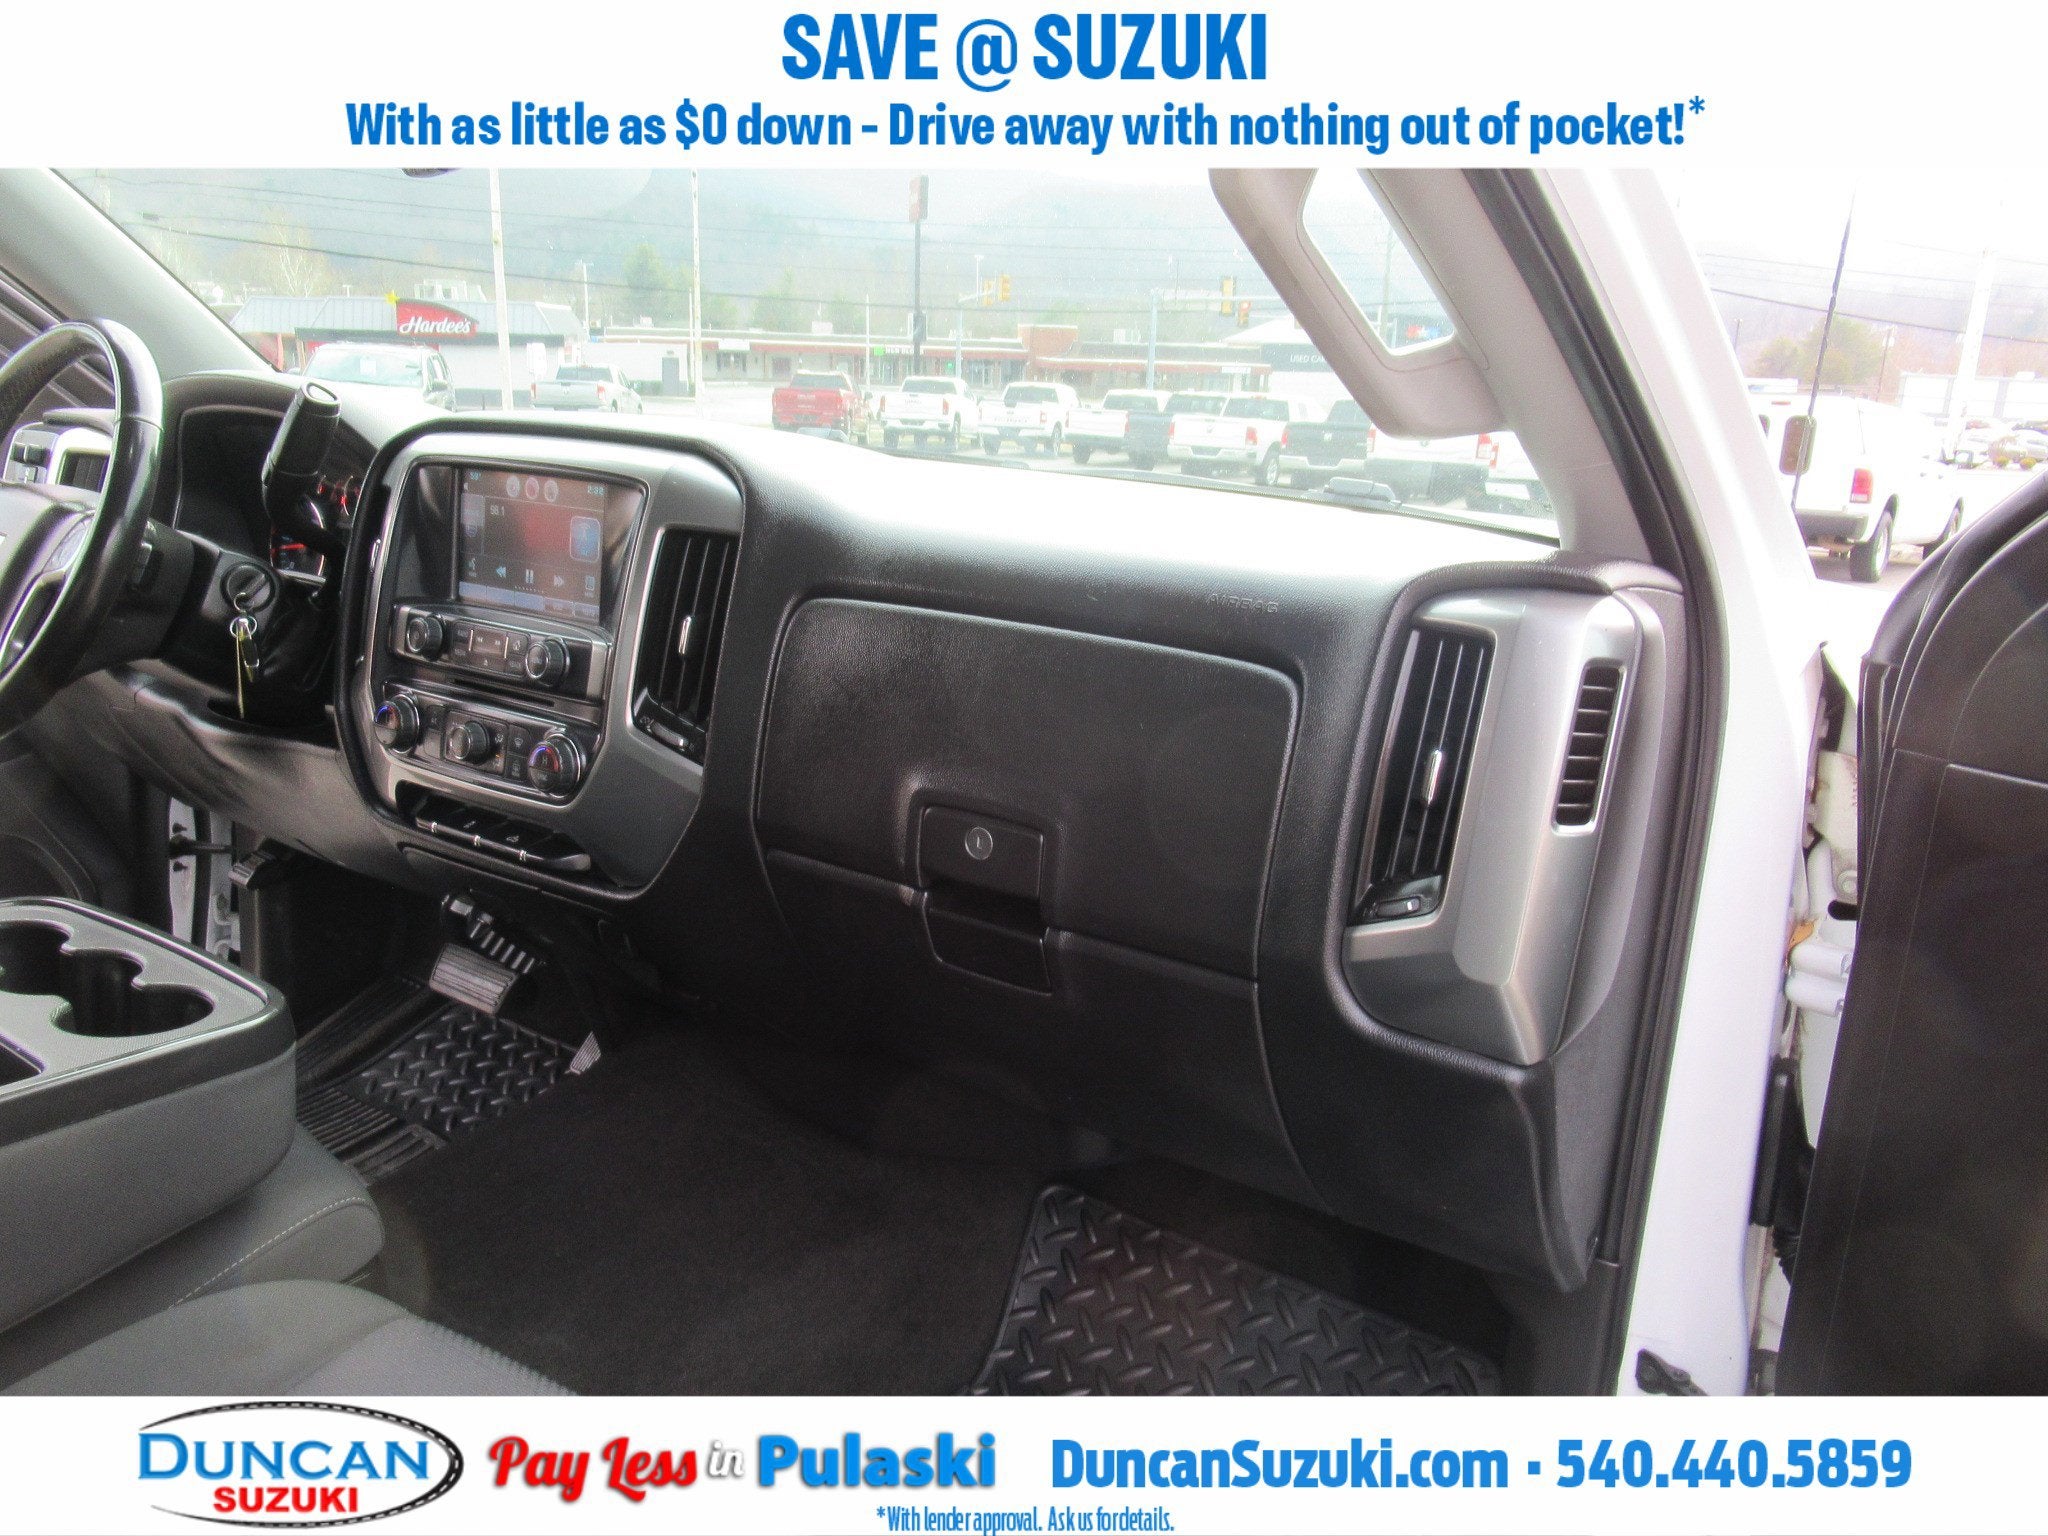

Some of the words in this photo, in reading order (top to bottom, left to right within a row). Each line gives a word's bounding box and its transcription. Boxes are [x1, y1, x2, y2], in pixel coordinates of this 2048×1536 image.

[397, 315, 472, 335] Hardee's
[1290, 354, 1310, 363] USED
[1206, 593, 1280, 613] AIRBAG
